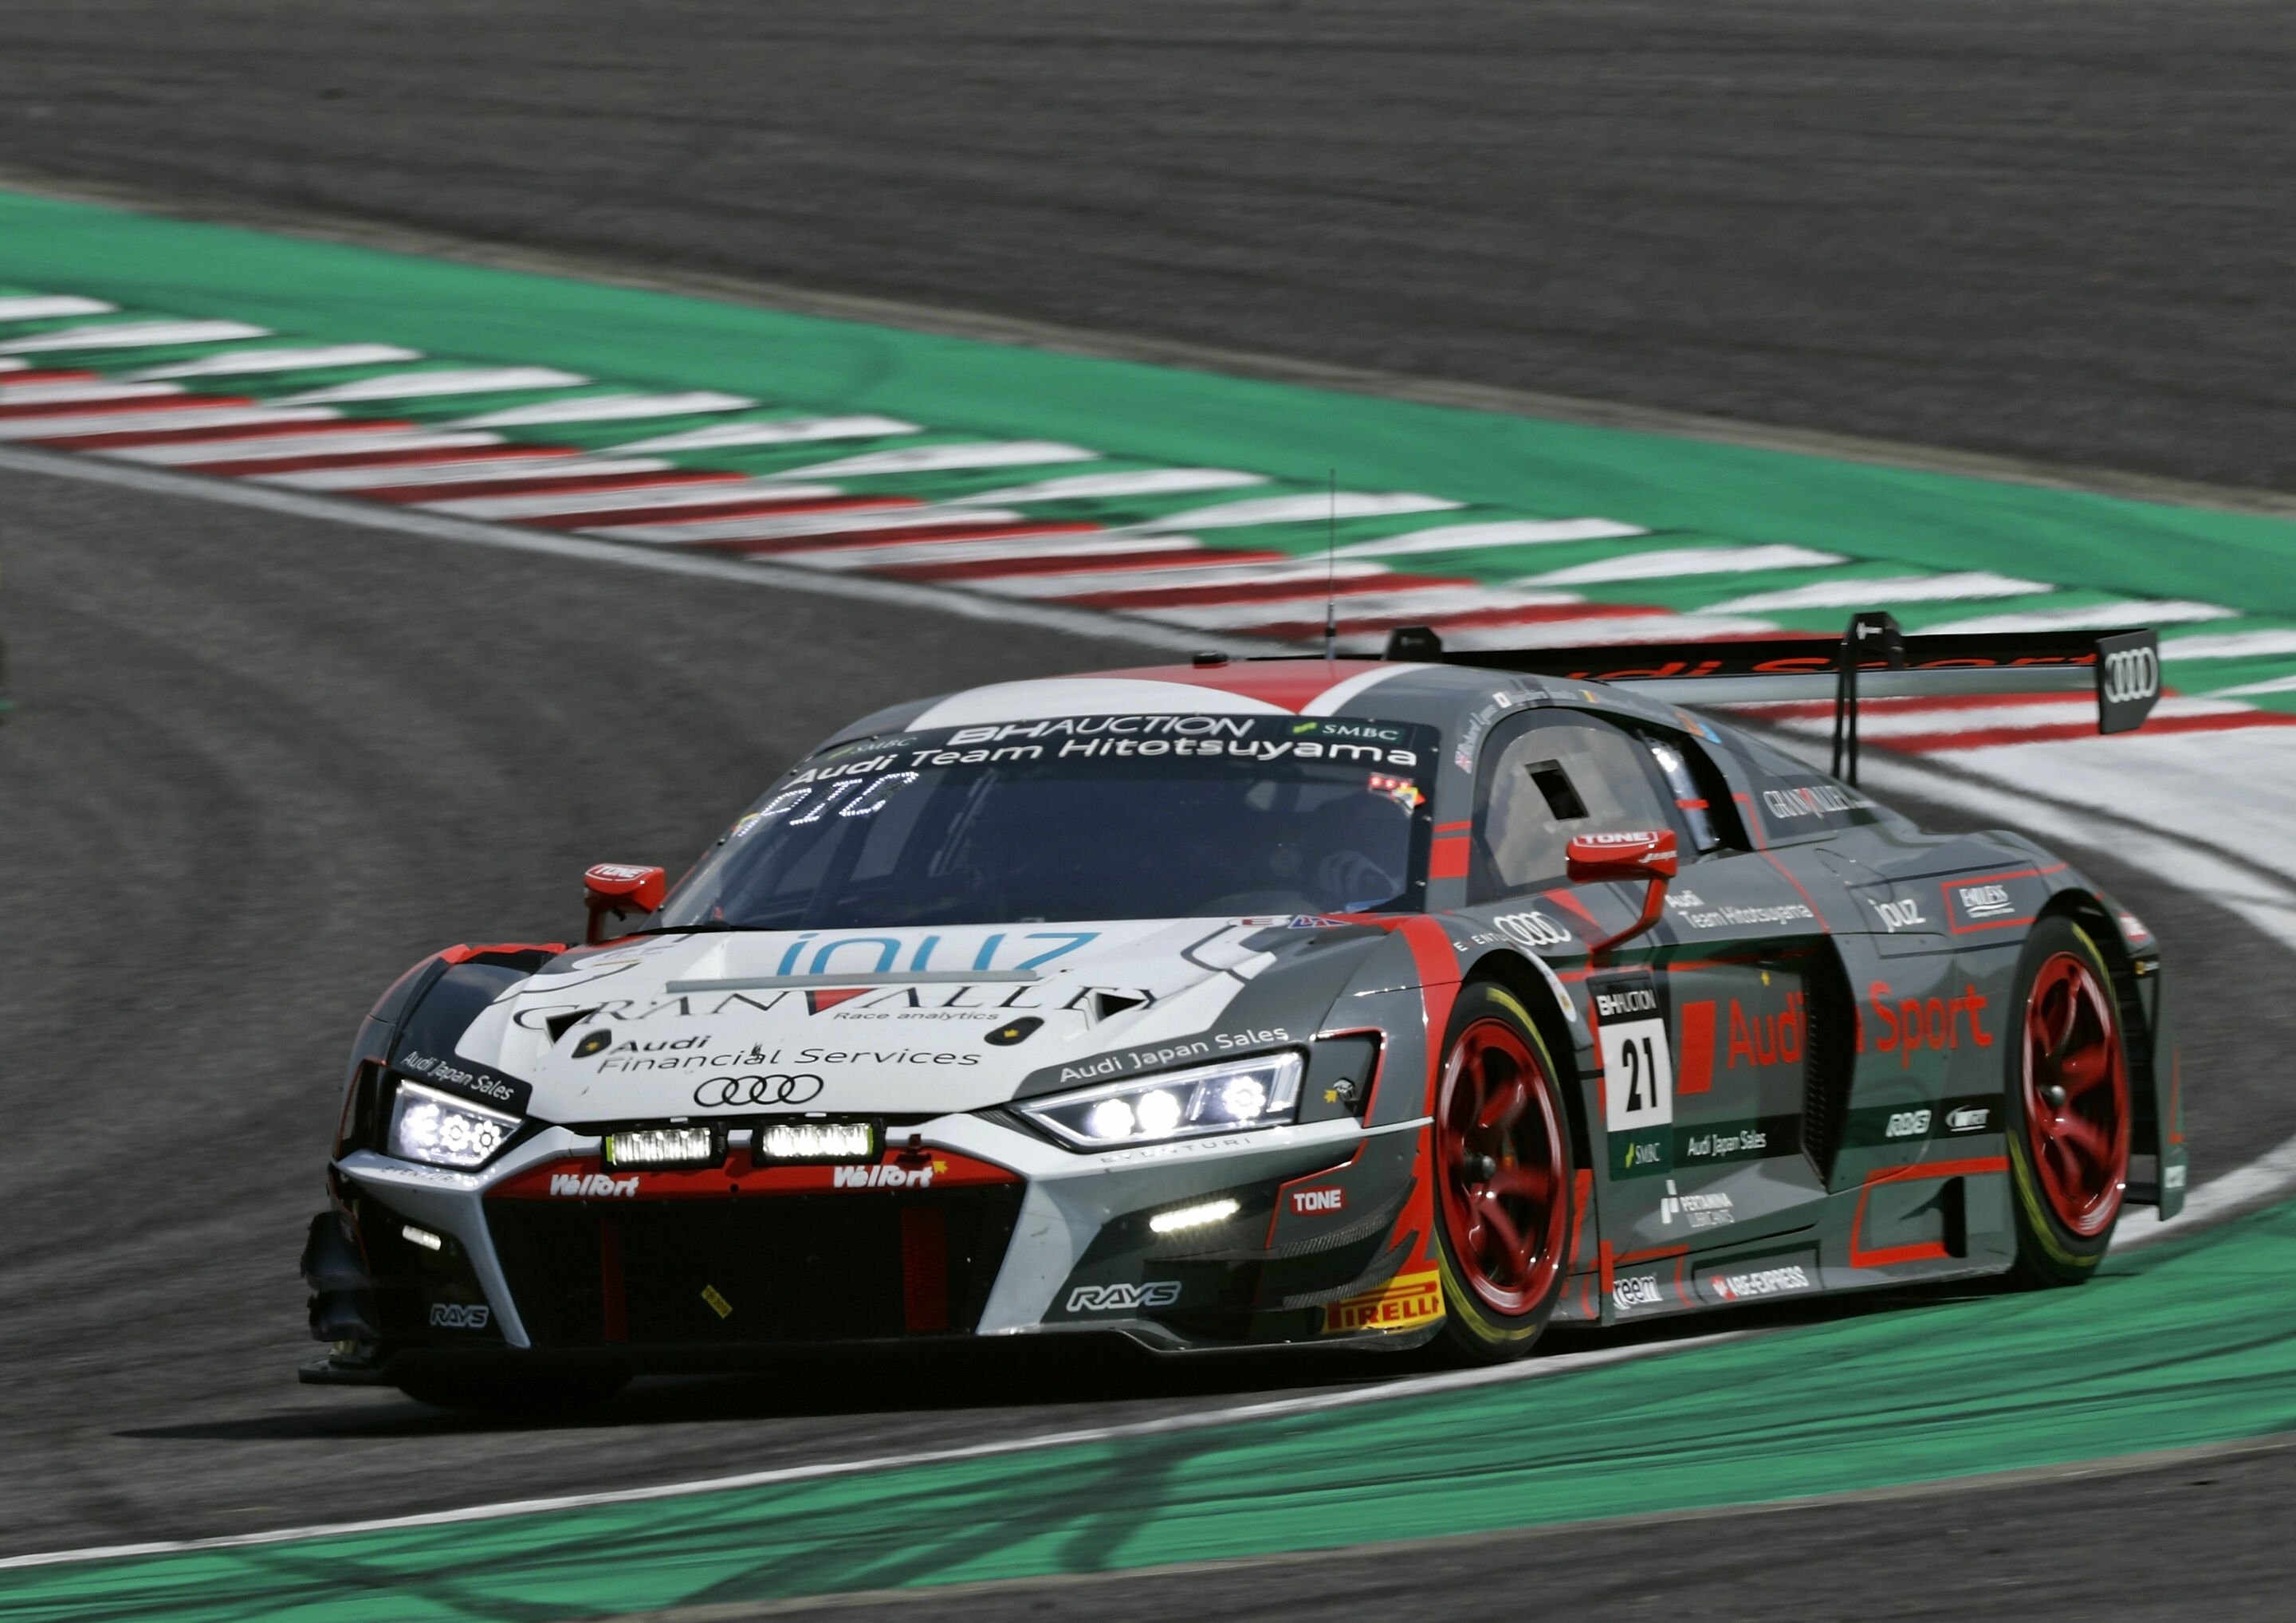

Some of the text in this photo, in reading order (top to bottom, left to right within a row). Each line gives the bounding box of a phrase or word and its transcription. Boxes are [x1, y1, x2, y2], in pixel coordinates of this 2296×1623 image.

[1323, 724, 1400, 741] SMBC
[781, 737, 1417, 791] Audi Team Hitotsuyama
[1579, 831, 1650, 844] TONE
[832, 1012, 1000, 1022] Race analytics
[1869, 980, 1994, 1070] Sport
[608, 1035, 713, 1055] Audi
[1060, 1028, 1289, 1083] Audi Japan Sales
[597, 1048, 982, 1074] Financial Services
[1622, 1036, 1657, 1112] 21
[401, 1051, 514, 1101] Audi Japan Sales
[1687, 1130, 1767, 1157] Audi Japan Sales
[1293, 1189, 1342, 1212] TONE
[1066, 1280, 1182, 1312] RAYS
[1327, 1280, 1439, 1330] PIRELLI
[430, 1303, 489, 1328] RAYS
